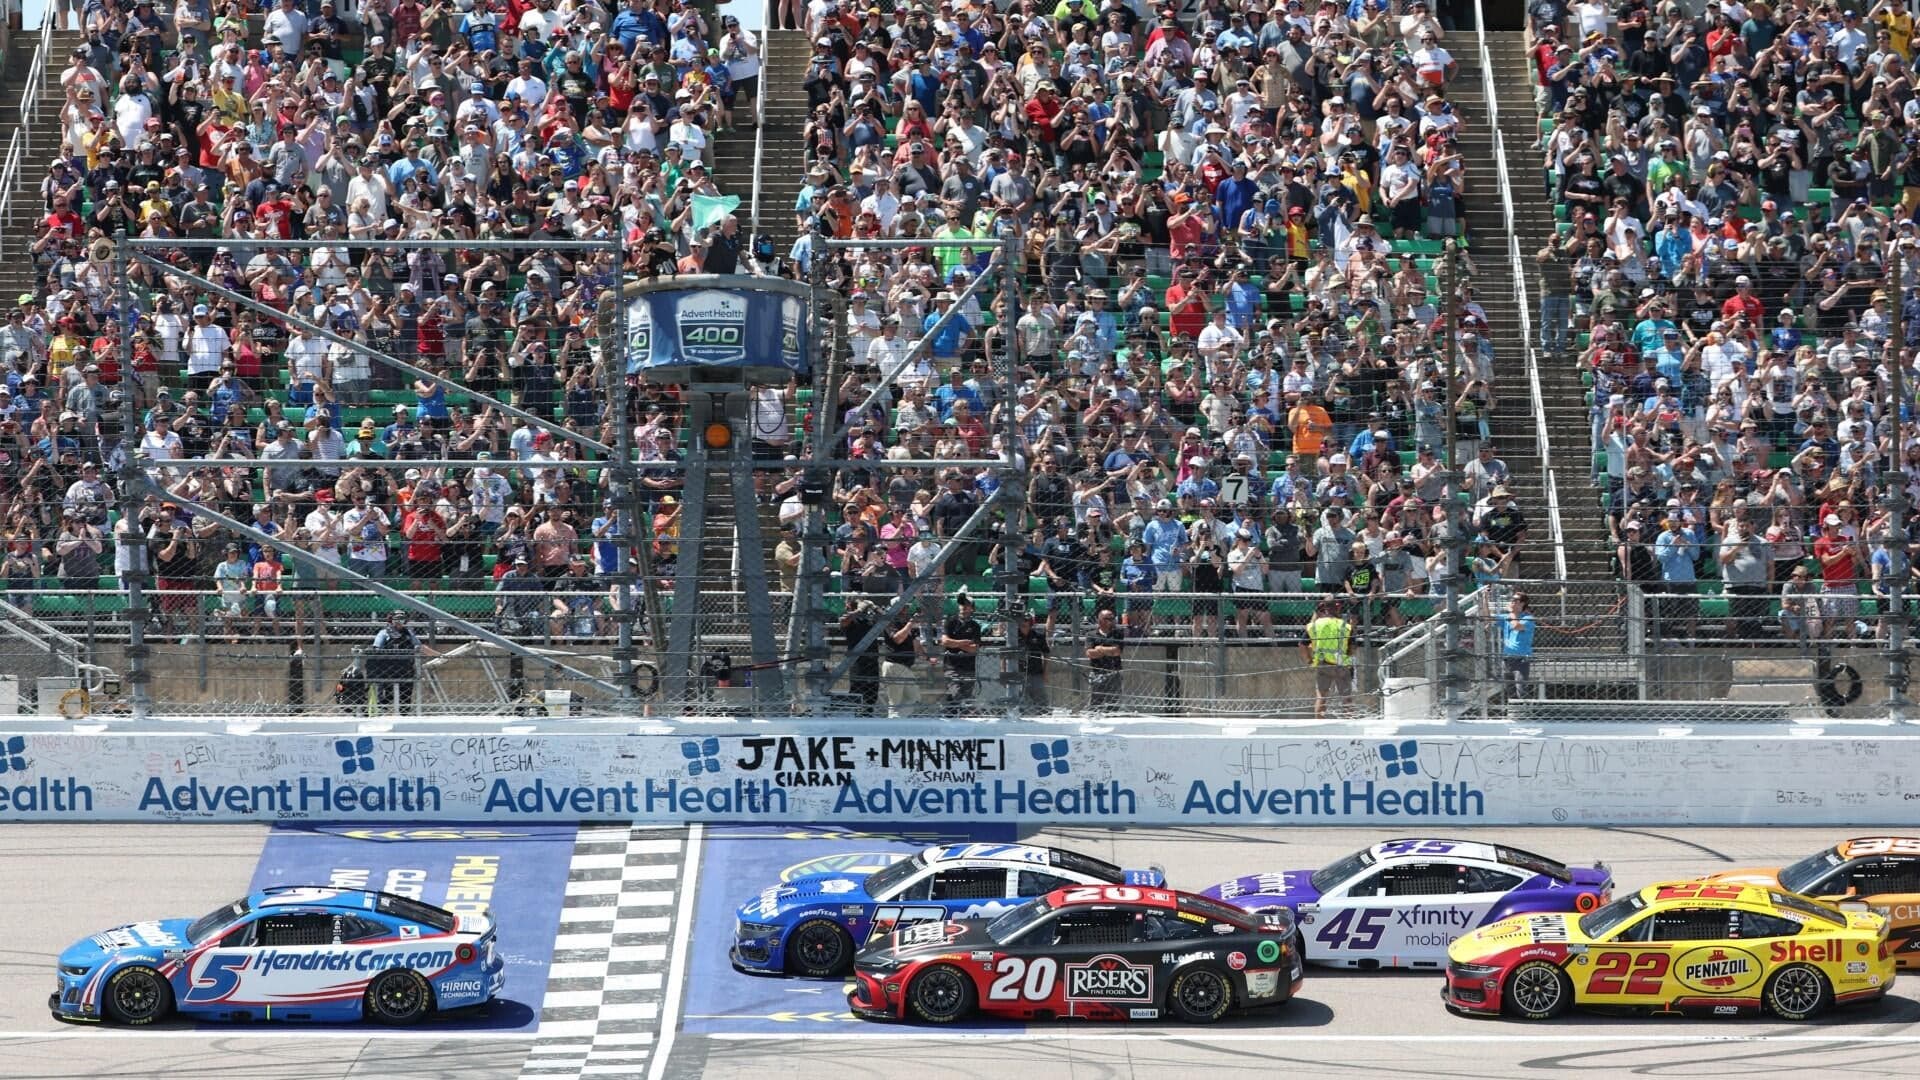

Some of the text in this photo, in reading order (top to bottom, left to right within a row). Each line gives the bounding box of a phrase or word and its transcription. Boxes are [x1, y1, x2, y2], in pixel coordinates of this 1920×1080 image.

[686, 327, 739, 343] 400
[1226, 478, 1243, 500] 7
[184, 744, 217, 767] BEN
[450, 737, 510, 756] CRAIG
[738, 736, 856, 771] JAKE
[481, 752, 535, 774] LEESHA
[775, 771, 852, 788] CIARAN
[922, 770, 976, 785] SHAWN
[1383, 841, 1457, 855] 45
[1064, 886, 1143, 903] 20
[1656, 884, 1745, 900] 22
[799, 908, 838, 918] GOODYEAR
[1396, 904, 1474, 929] xfinity
[1315, 908, 1394, 950] 45
[1405, 932, 1460, 947] mobile
[1520, 948, 1557, 958] GOODYEAR
[1769, 939, 1843, 962] Shell
[184, 954, 252, 1001] 5
[988, 957, 1058, 1001] 20
[1585, 952, 1670, 996] 22
[1685, 959, 1749, 980] PENNZOIL
[440, 980, 481, 993] HIRING
[1073, 968, 1147, 996] RESER'S
[1132, 1009, 1150, 1018] Mobil
[1713, 1005, 1738, 1014] FORD
